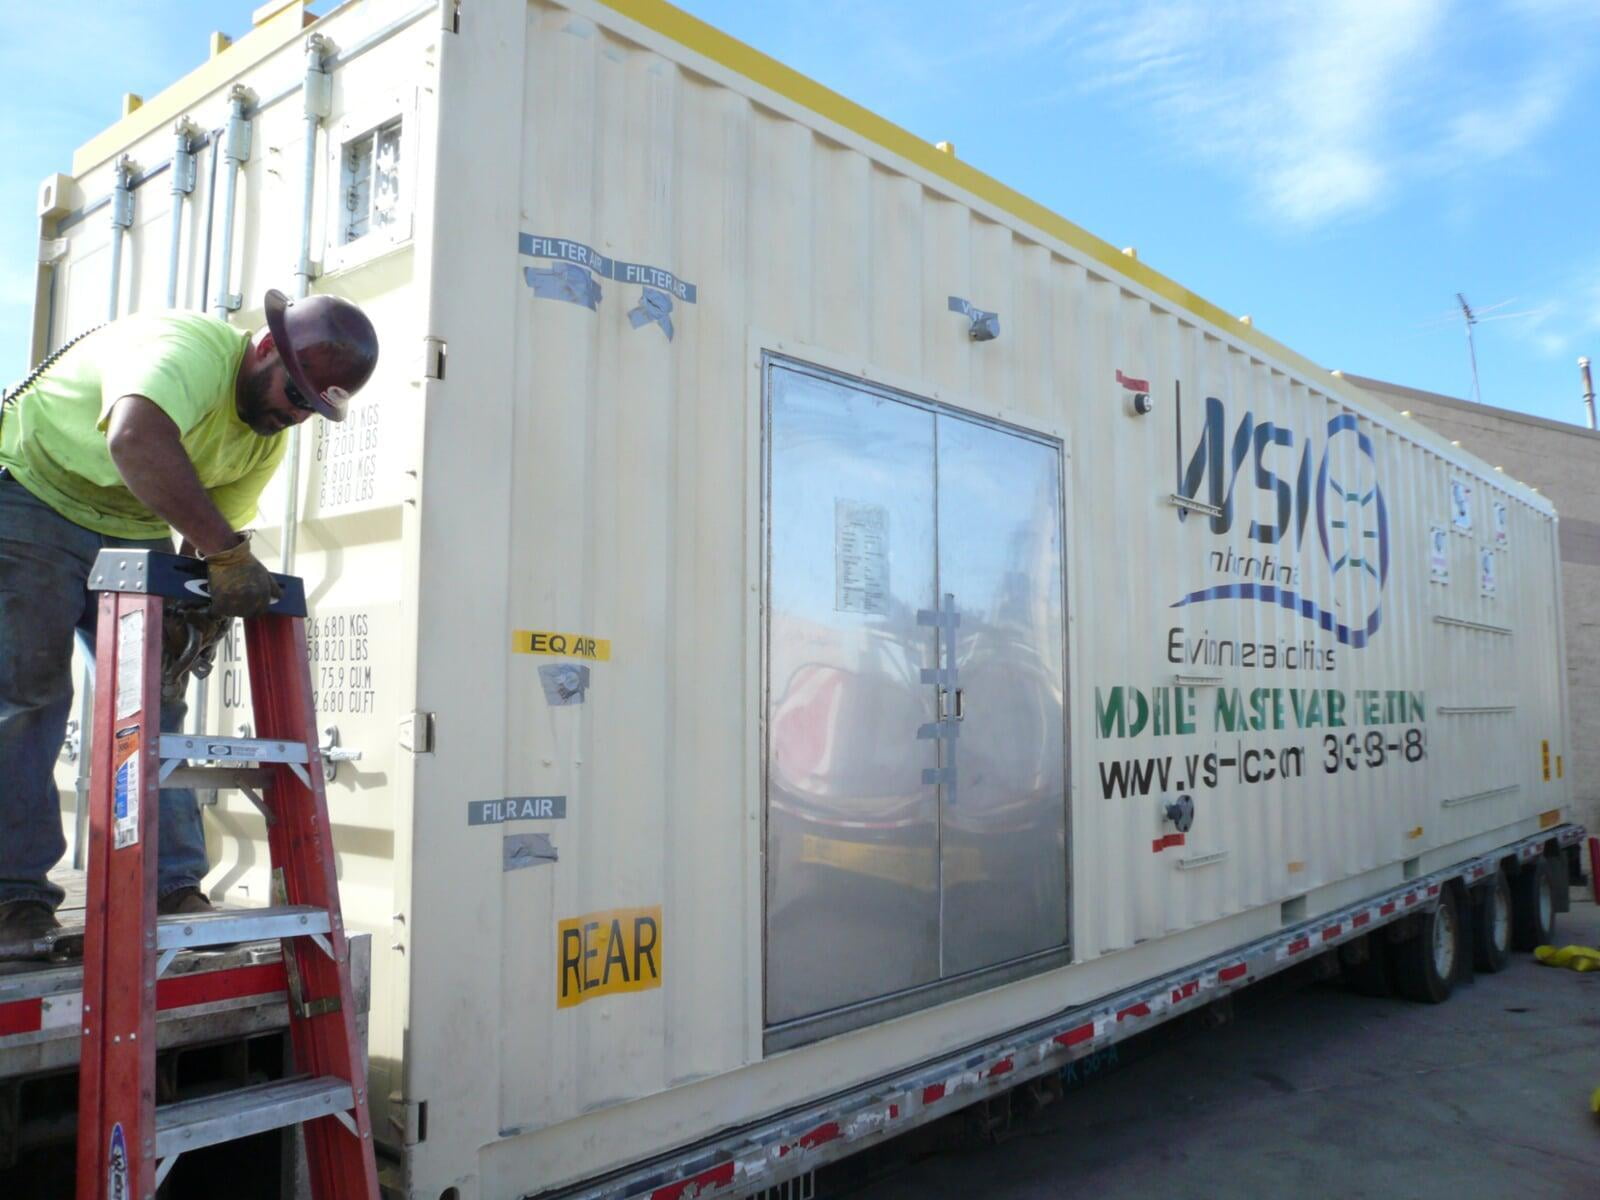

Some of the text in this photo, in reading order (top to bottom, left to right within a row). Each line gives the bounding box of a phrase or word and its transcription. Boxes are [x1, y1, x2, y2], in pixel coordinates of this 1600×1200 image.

[532, 238, 604, 273] FILTER AIR
[626, 264, 673, 290] FILTER
[360, 403, 380, 428] KGS
[356, 453, 377, 478] KGS
[355, 478, 374, 502] LBS
[306, 616, 345, 639] 26.680
[350, 614, 369, 636] KGS
[350, 638, 369, 661] LBS
[530, 633, 597, 658] EQ AIR
[321, 667, 345, 689] 75.9
[520, 799, 554, 817] AIR
[561, 916, 658, 998] REAR
